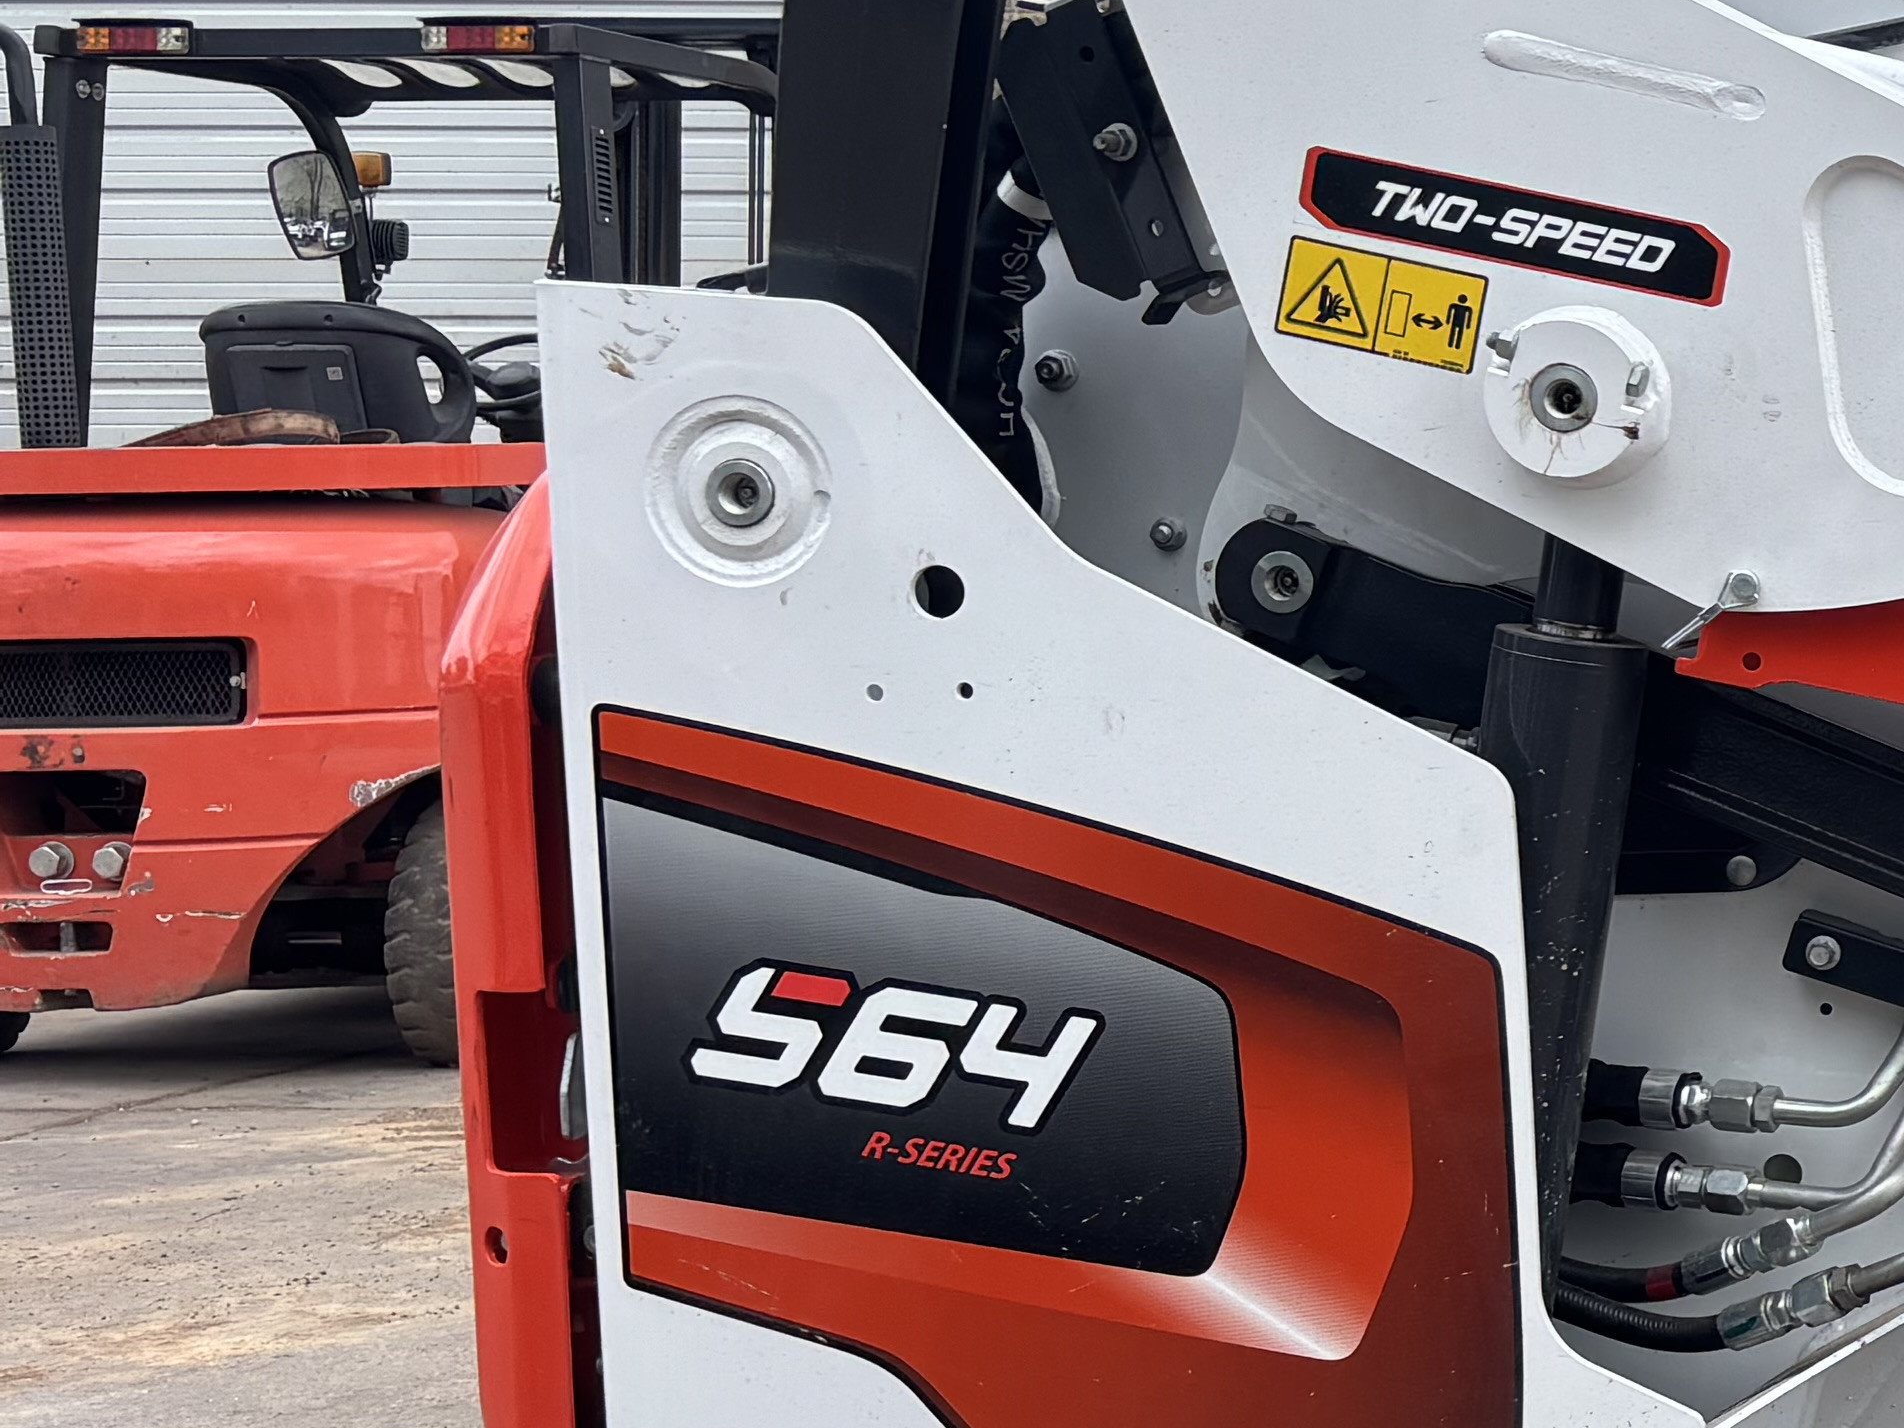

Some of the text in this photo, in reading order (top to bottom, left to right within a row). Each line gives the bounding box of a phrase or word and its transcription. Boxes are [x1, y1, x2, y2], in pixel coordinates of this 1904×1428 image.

[1372, 181, 1677, 274] TWO-SPEED
[692, 966, 1102, 1128] S64
[862, 1131, 1017, 1180] R-SERIES
